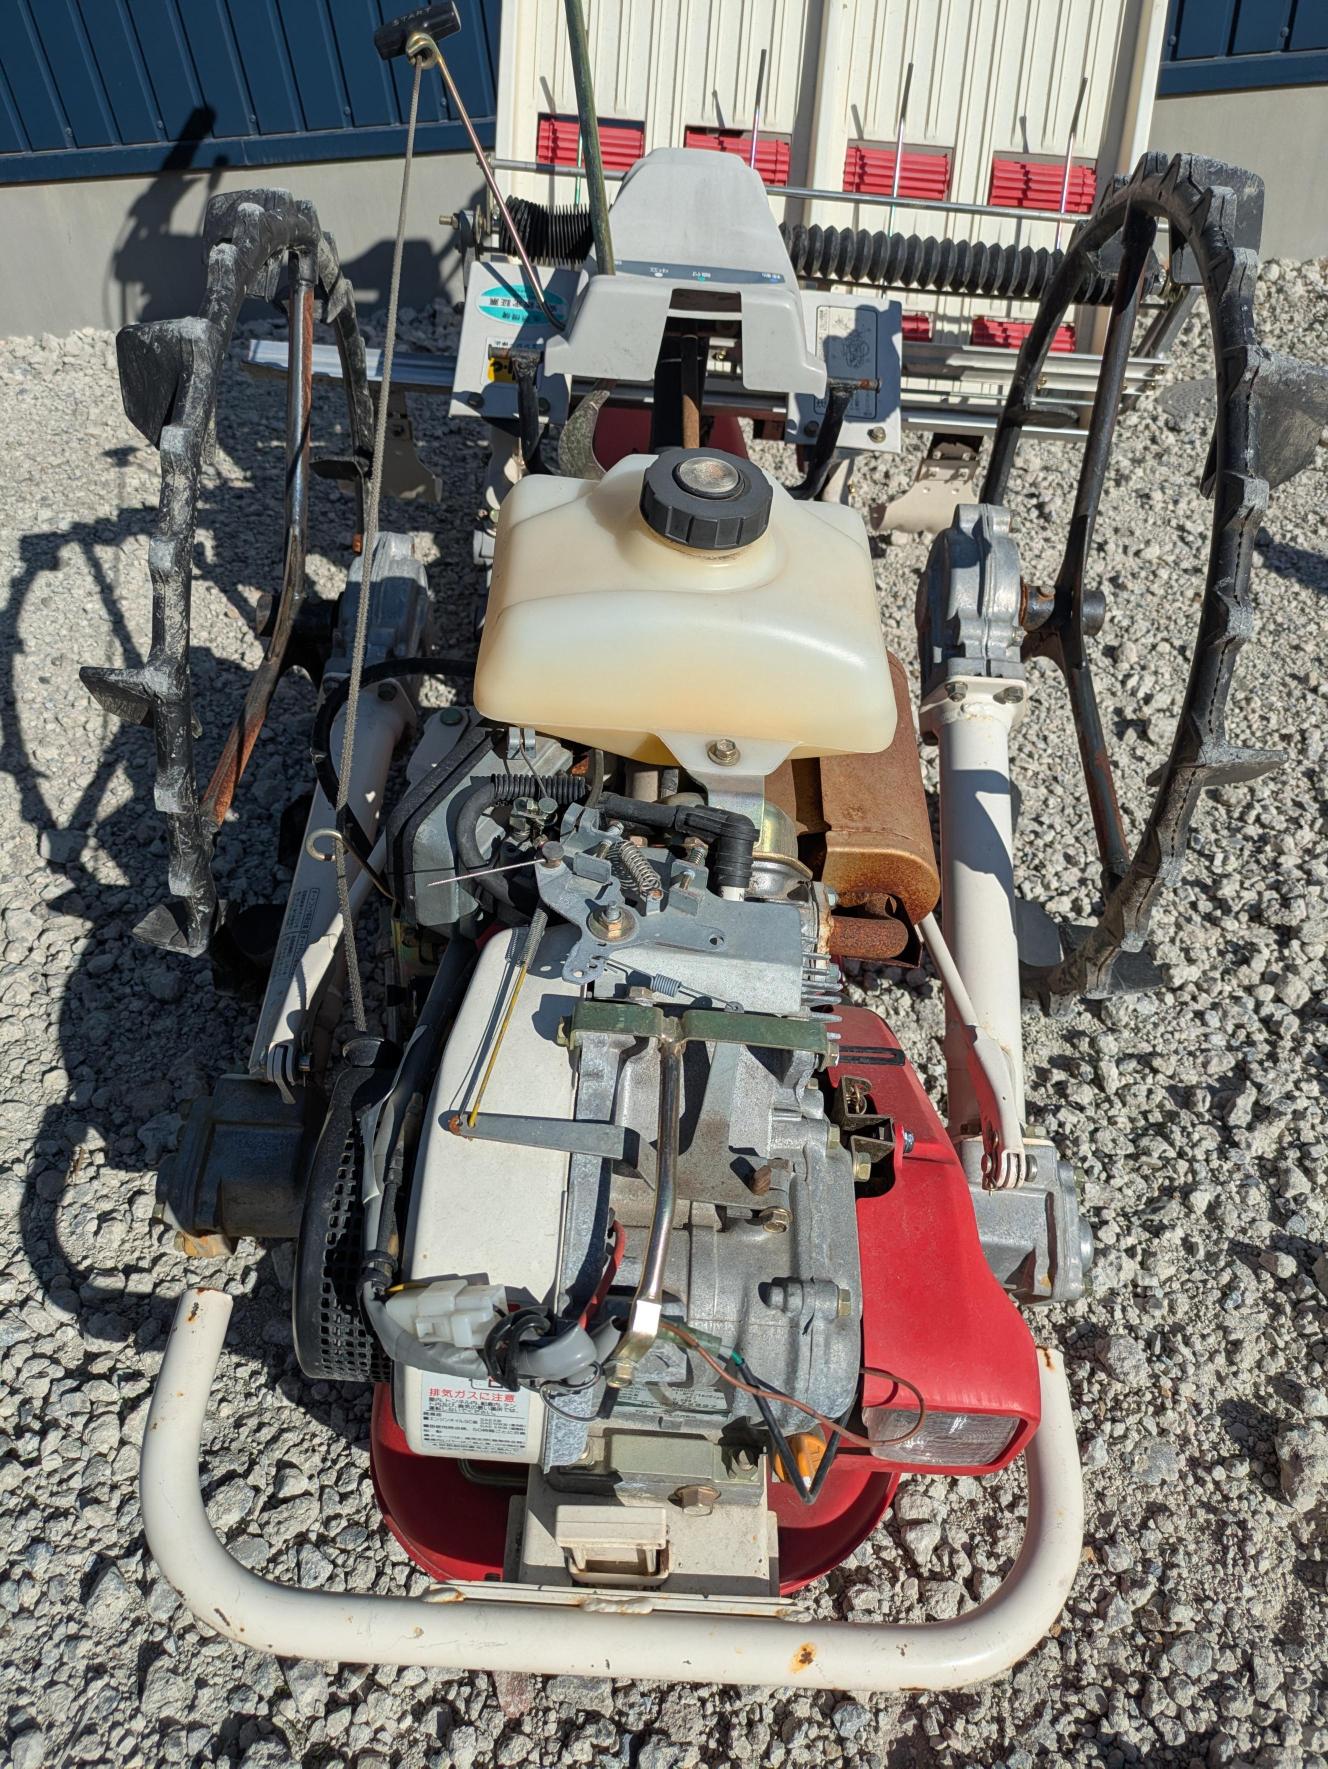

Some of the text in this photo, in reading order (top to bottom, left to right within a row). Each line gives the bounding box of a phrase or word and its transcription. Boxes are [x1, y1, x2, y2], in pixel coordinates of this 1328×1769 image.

[392, 7, 432, 26] START
[429, 1388, 515, 1403] 排気ガスに注意
